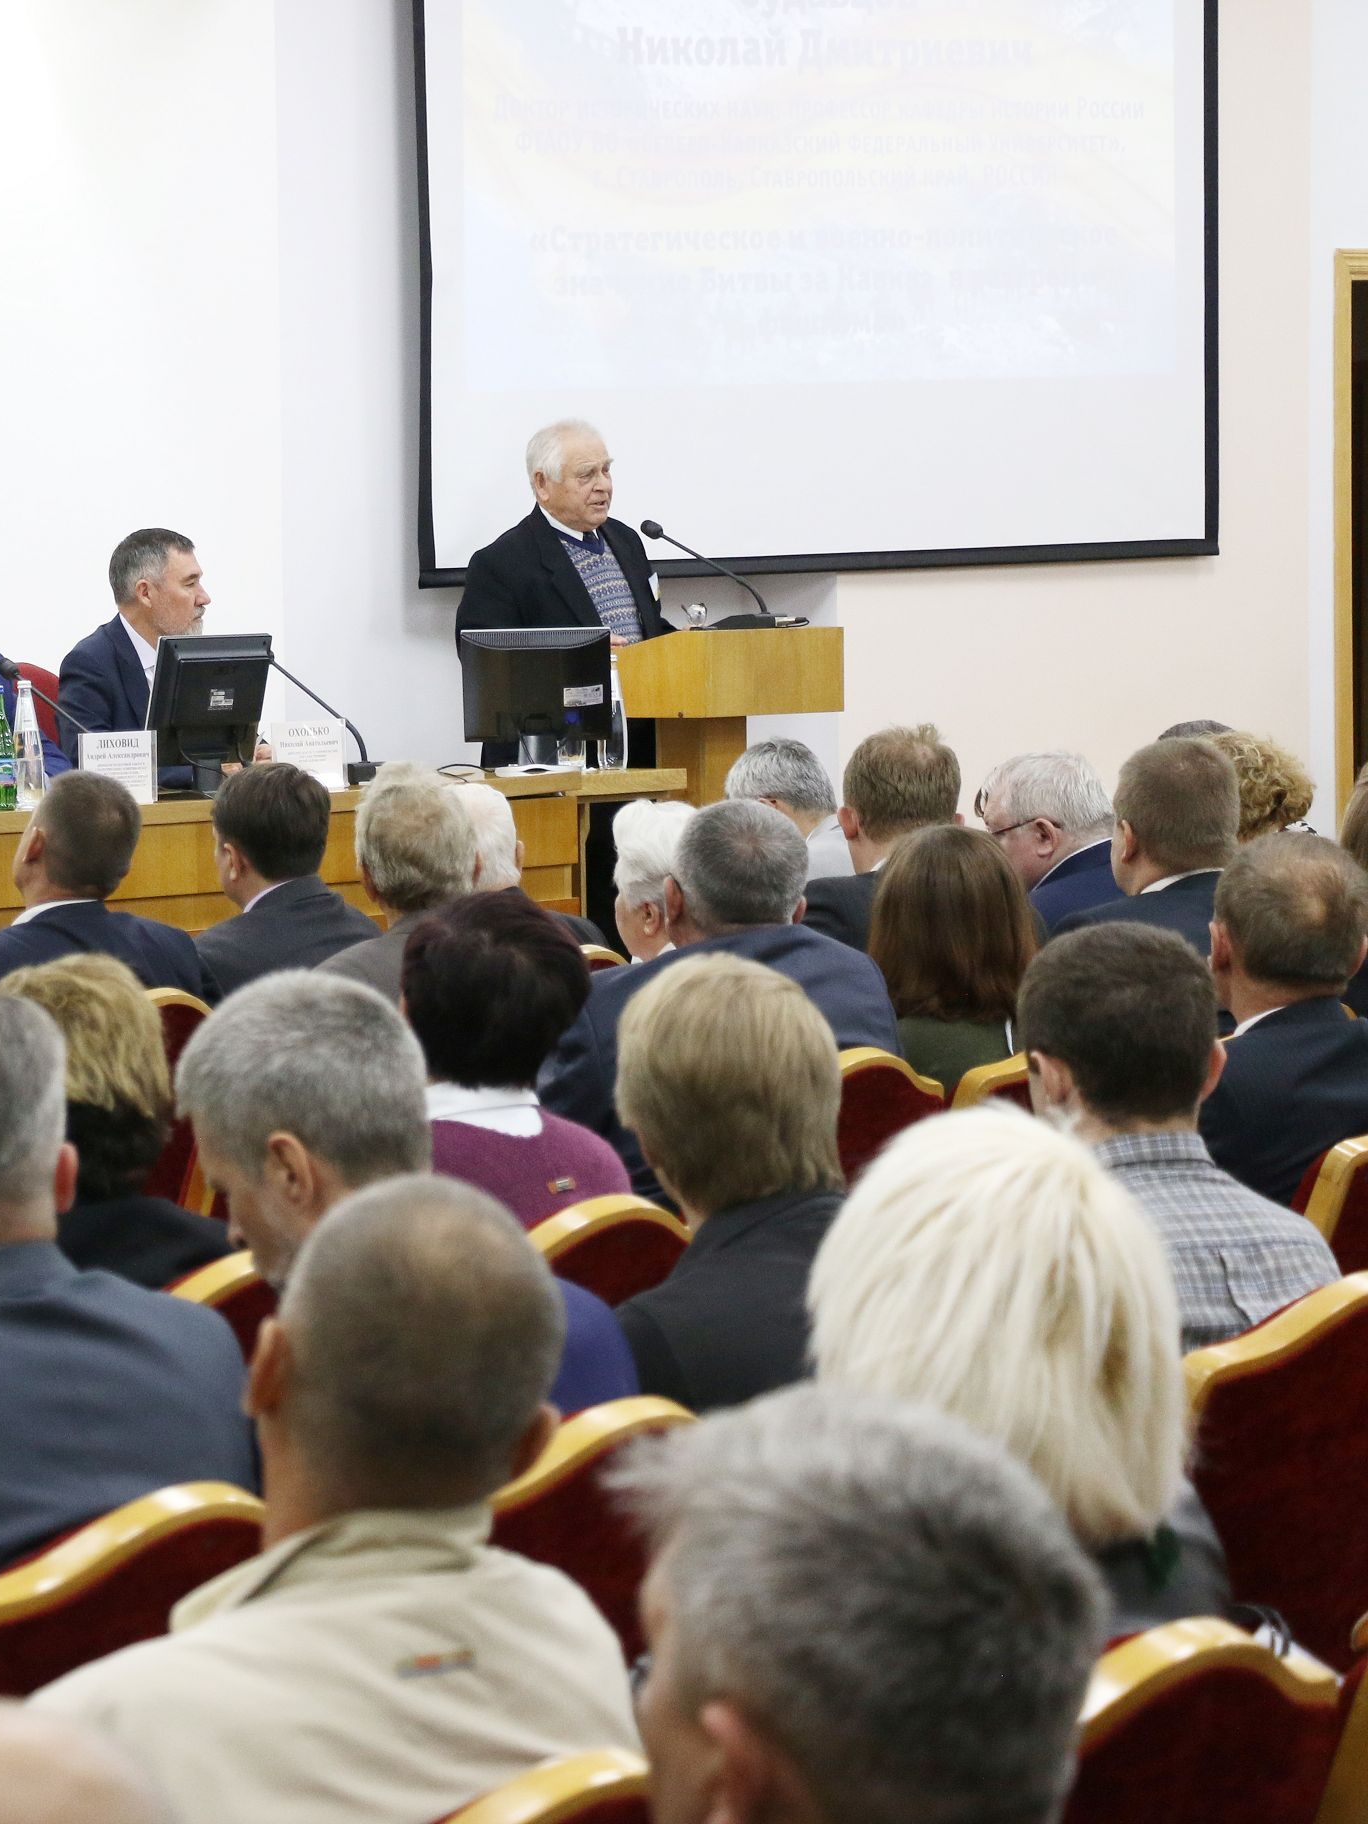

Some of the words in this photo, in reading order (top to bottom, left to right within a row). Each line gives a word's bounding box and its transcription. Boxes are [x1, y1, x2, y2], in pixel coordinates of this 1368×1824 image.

[616, 26, 786, 67] Николай
[797, 28, 1033, 76] Дмитриевич
[699, 265, 794, 295] Битвы
[799, 273, 830, 293] за
[96, 738, 139, 749] ЛИХОВИД
